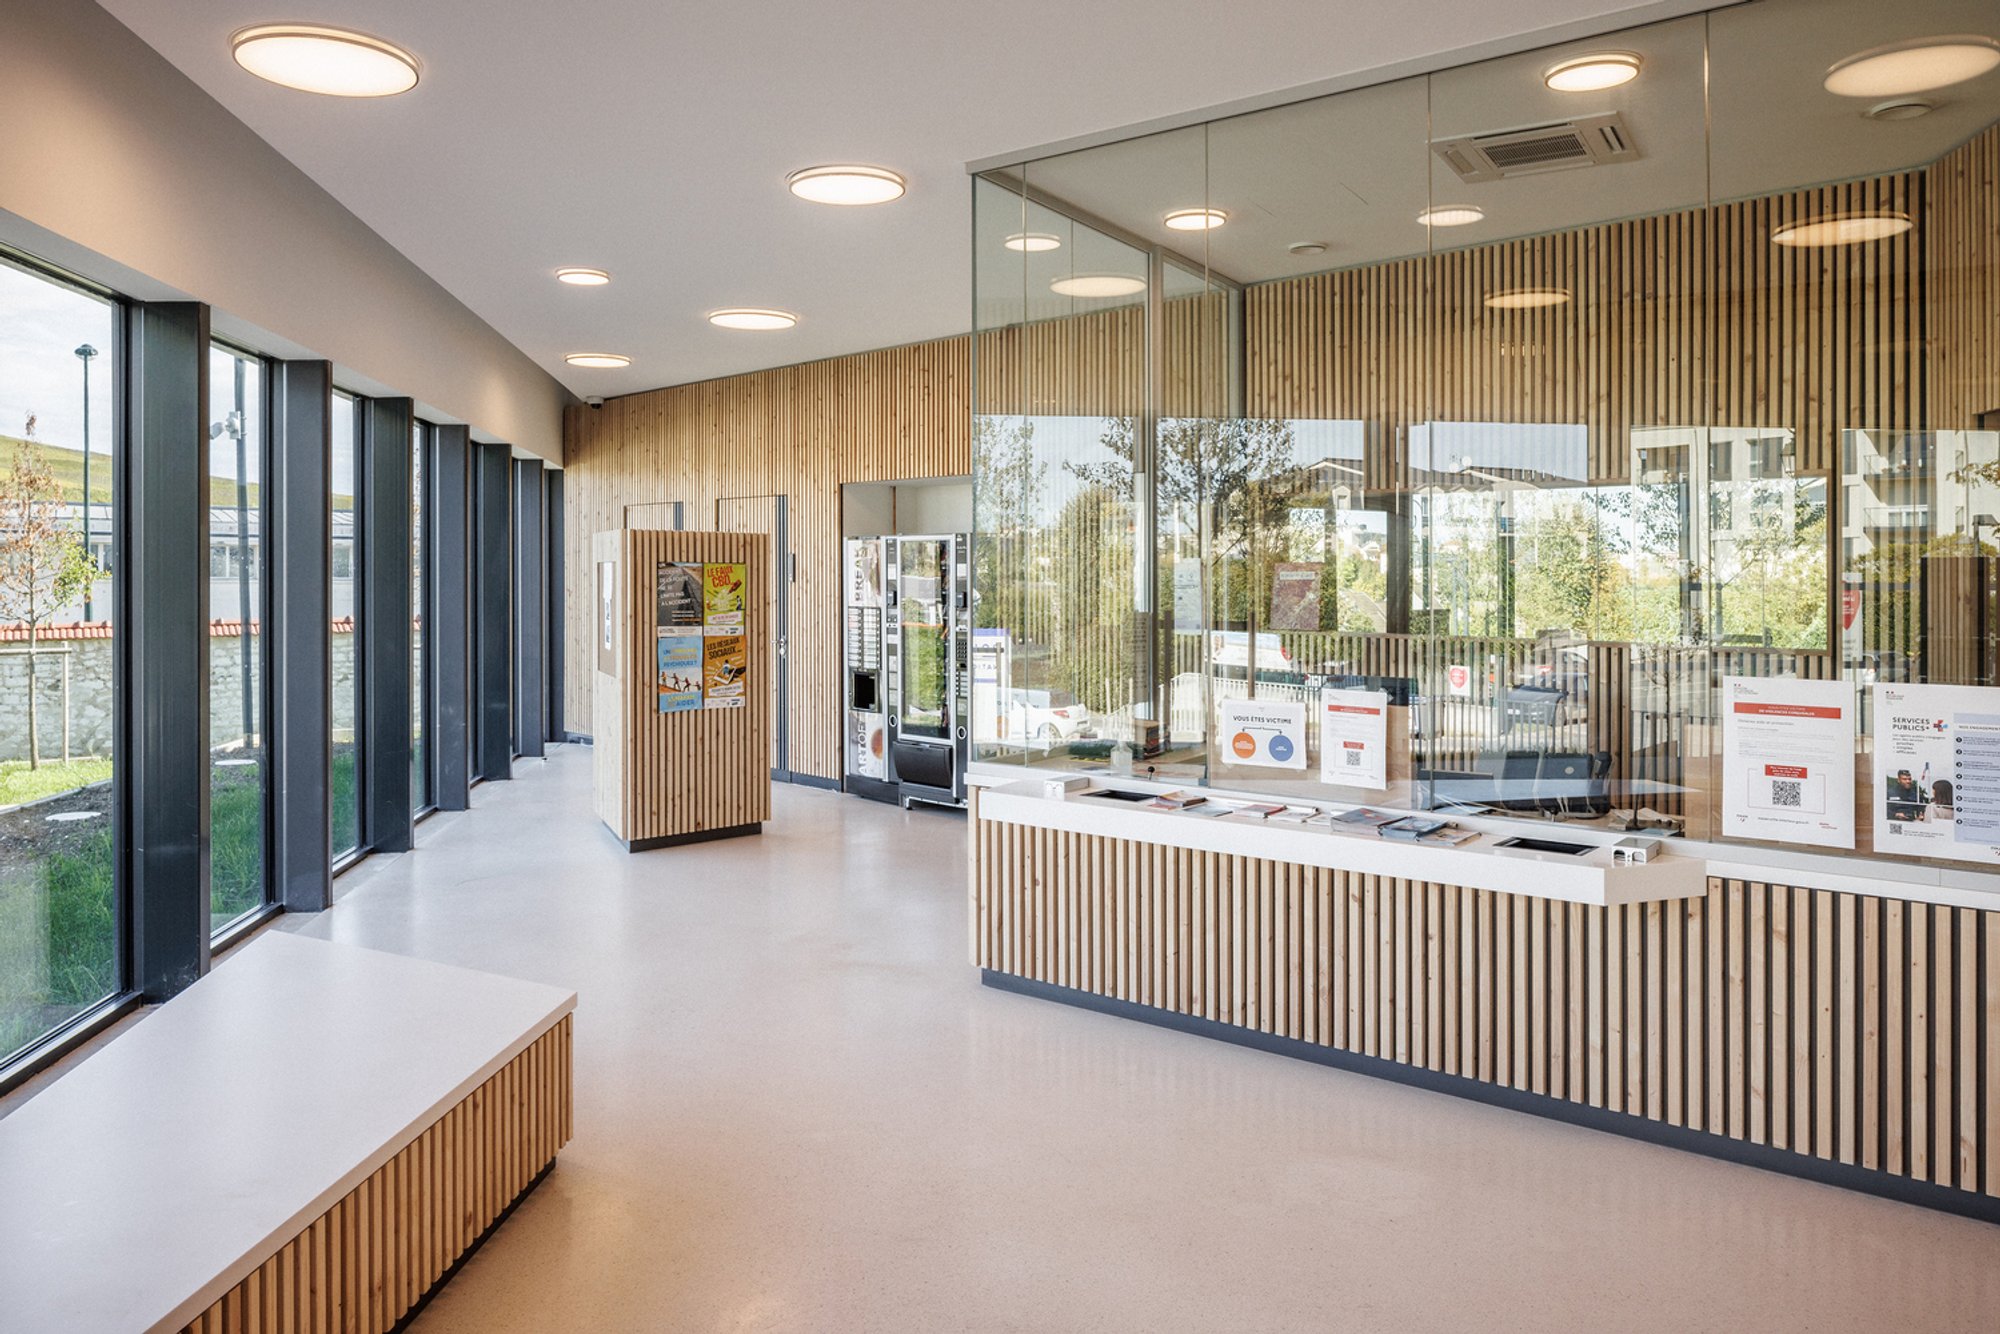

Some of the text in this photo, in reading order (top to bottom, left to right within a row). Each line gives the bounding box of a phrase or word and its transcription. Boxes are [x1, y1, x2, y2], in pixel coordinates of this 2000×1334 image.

[707, 567, 715, 578] LE
[706, 642, 718, 651] LES
[1892, 716, 1931, 725] SERVICES
